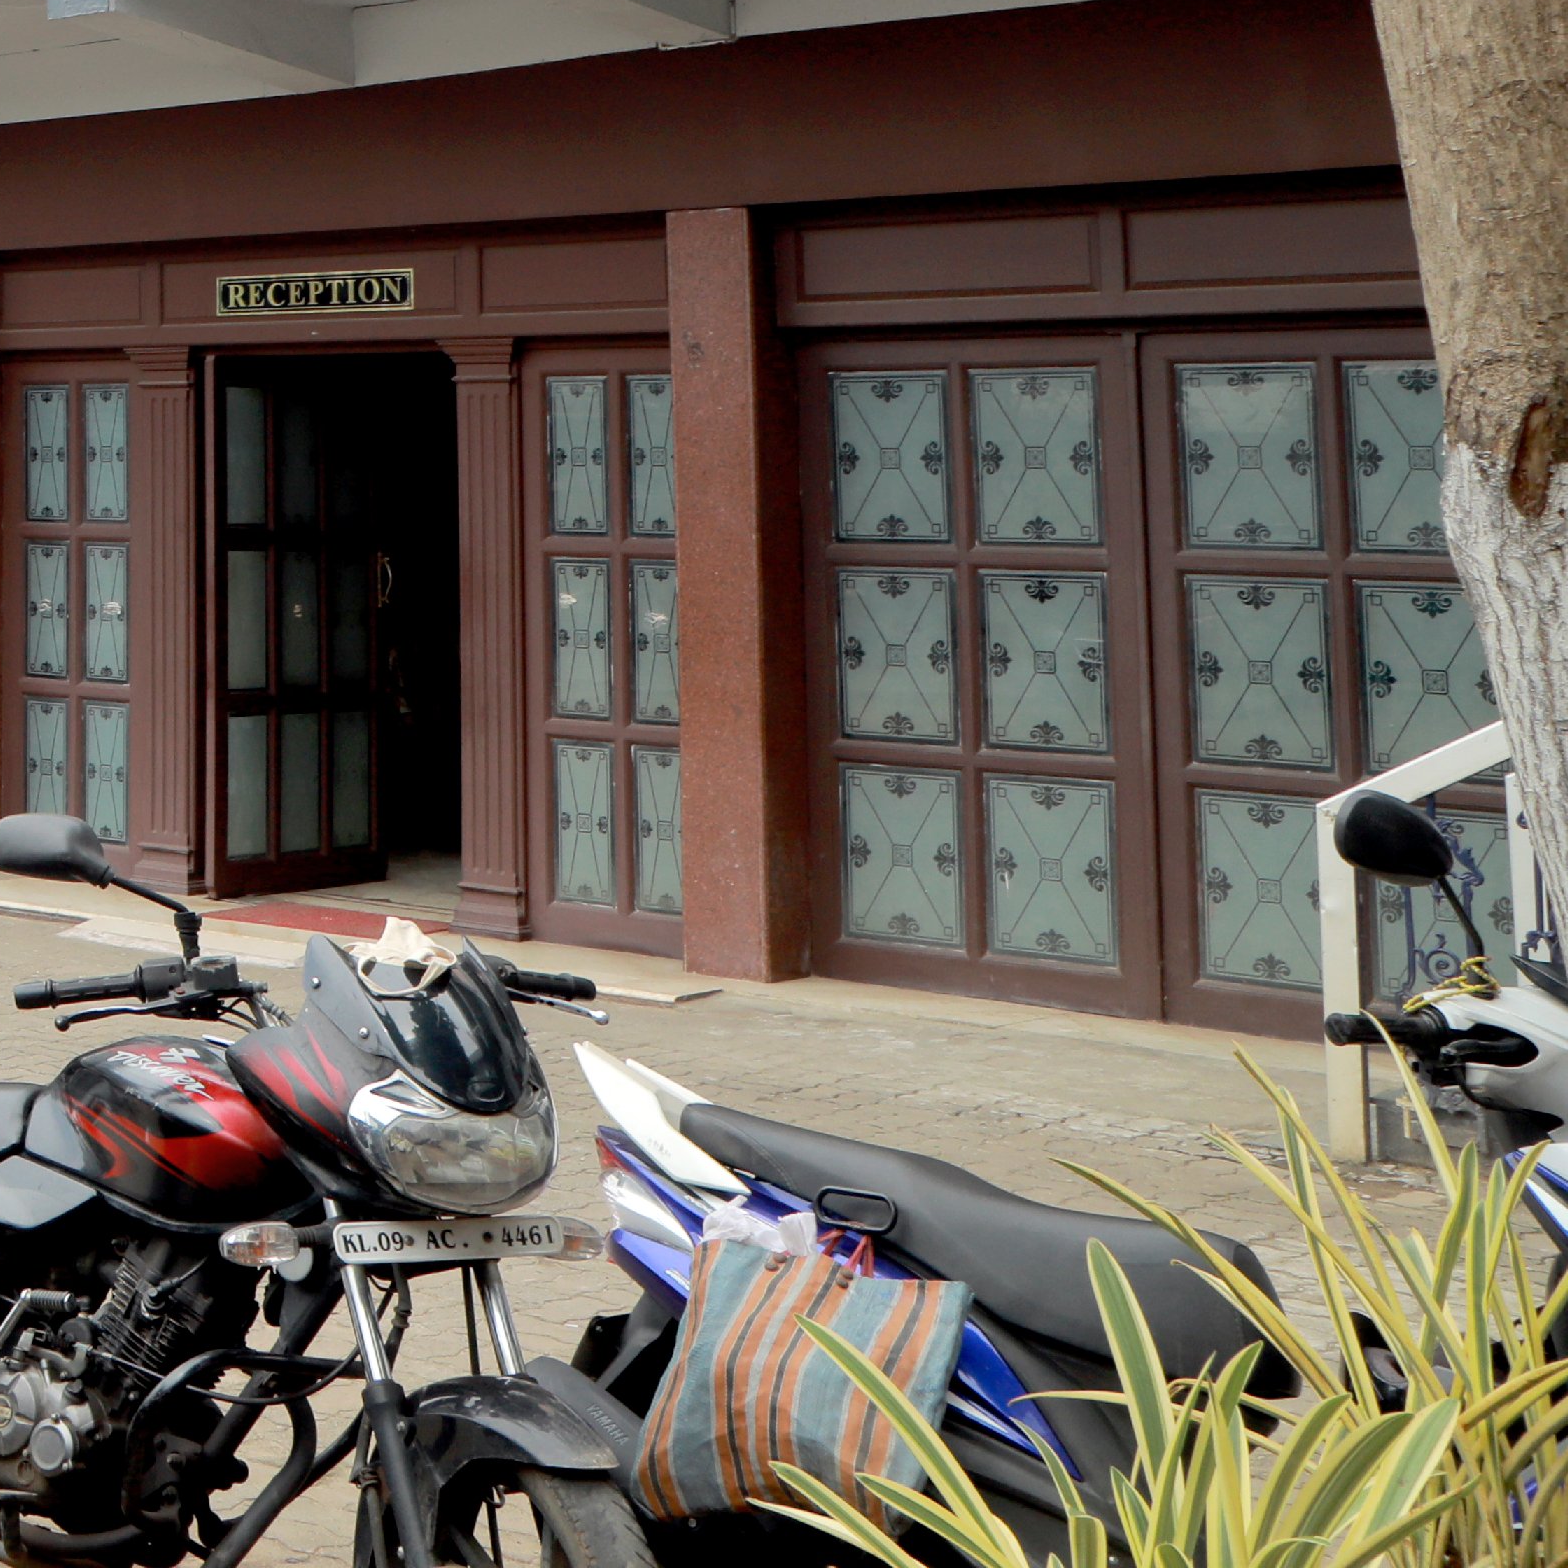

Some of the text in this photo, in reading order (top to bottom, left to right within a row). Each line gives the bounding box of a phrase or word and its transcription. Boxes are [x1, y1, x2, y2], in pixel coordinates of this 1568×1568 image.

[227, 277, 402, 308] RECEPTION
[501, 1224, 554, 1247] 4461
[586, 1403, 630, 1446] YAMAHA
